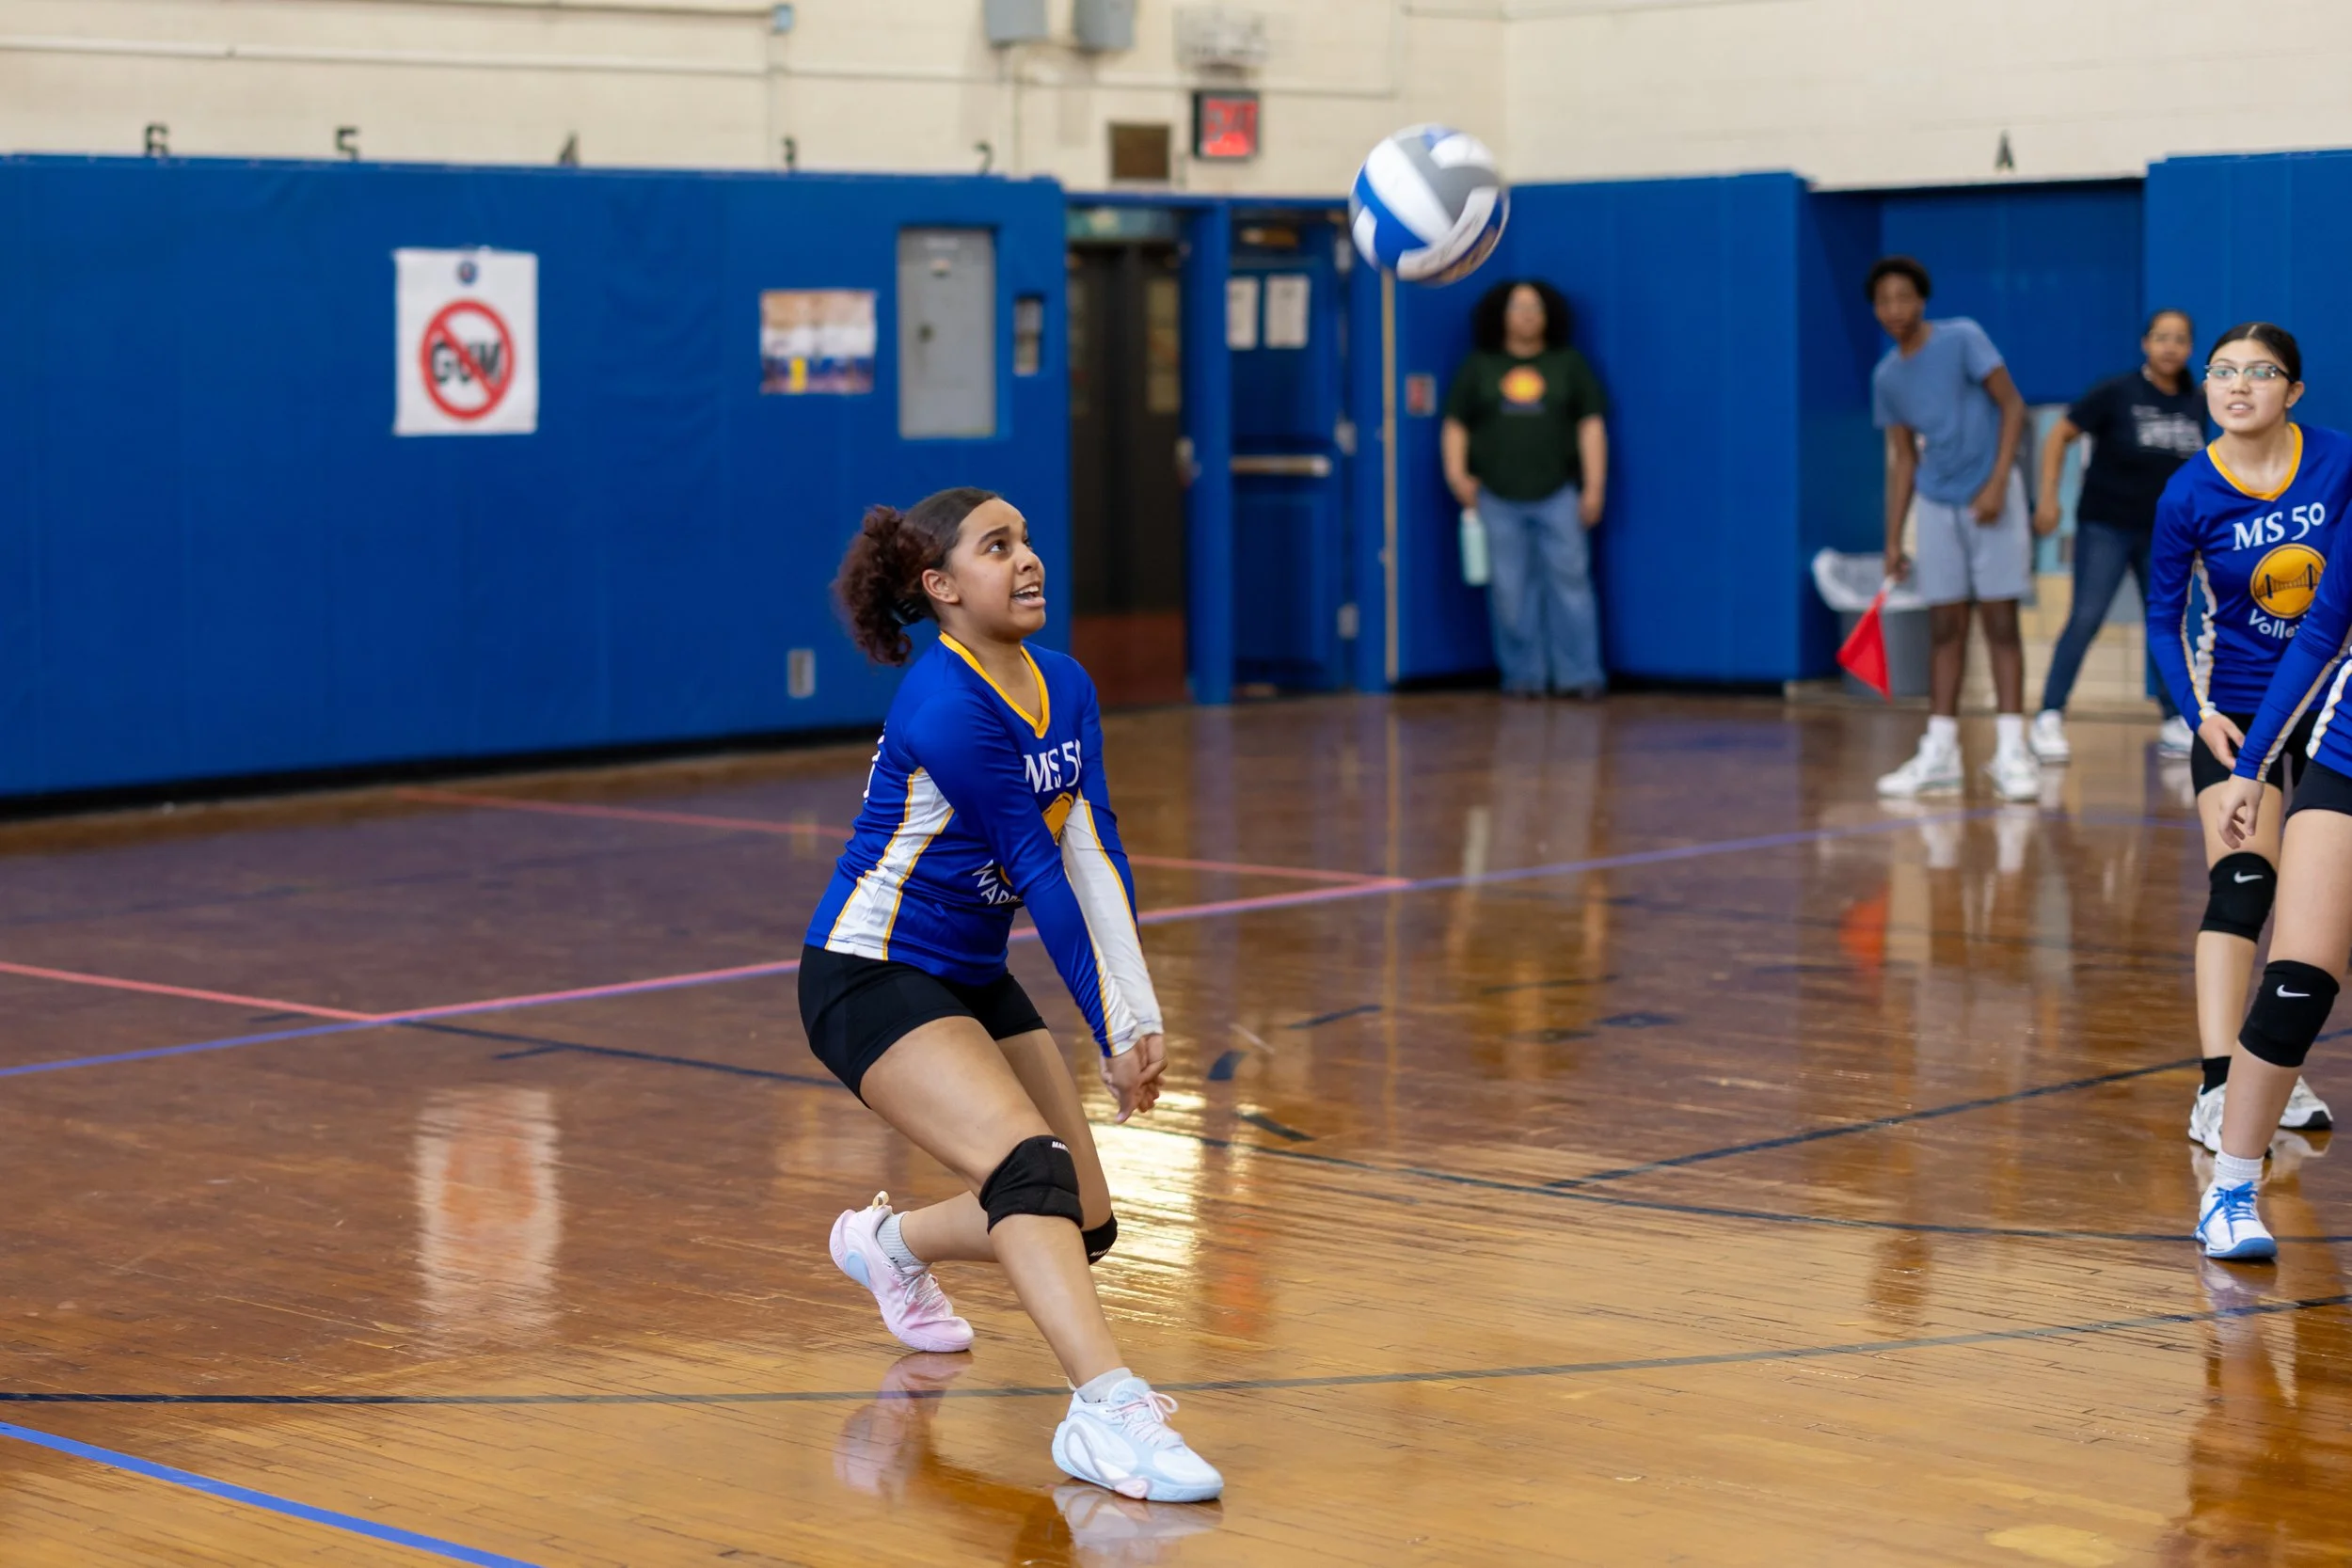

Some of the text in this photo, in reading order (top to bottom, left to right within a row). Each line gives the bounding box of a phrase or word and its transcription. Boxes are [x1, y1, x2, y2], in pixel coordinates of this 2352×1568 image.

[336, 127, 359, 161] 5
[2233, 502, 2326, 551] MS 50
[1023, 748, 1062, 794] MS
